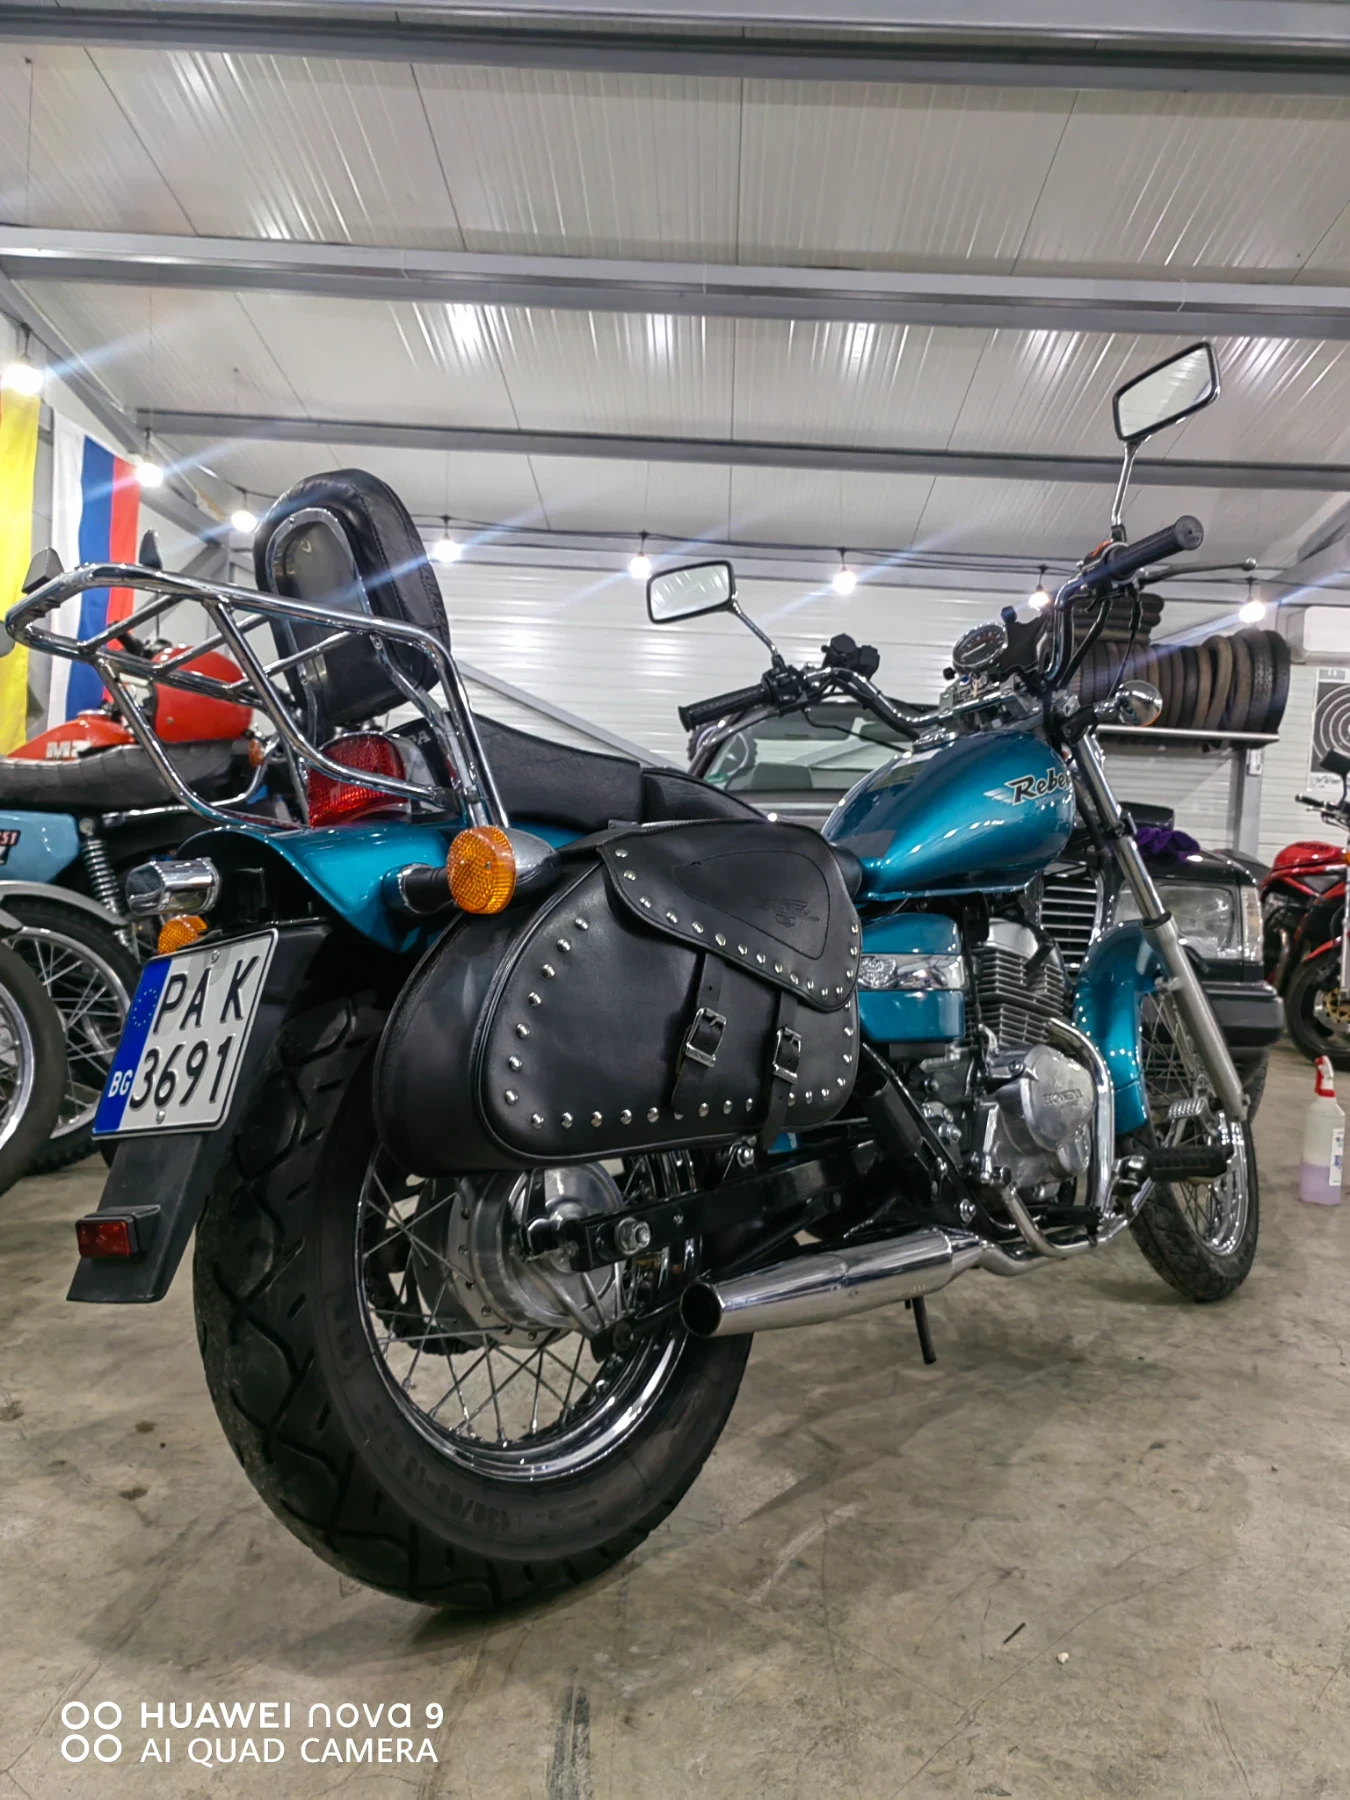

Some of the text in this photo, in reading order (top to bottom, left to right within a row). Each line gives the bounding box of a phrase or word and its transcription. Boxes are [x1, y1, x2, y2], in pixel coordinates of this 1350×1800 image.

[1004, 767, 1068, 806] Rebe
[108, 1069, 133, 1098] BG
[129, 1033, 236, 1110] 3691
